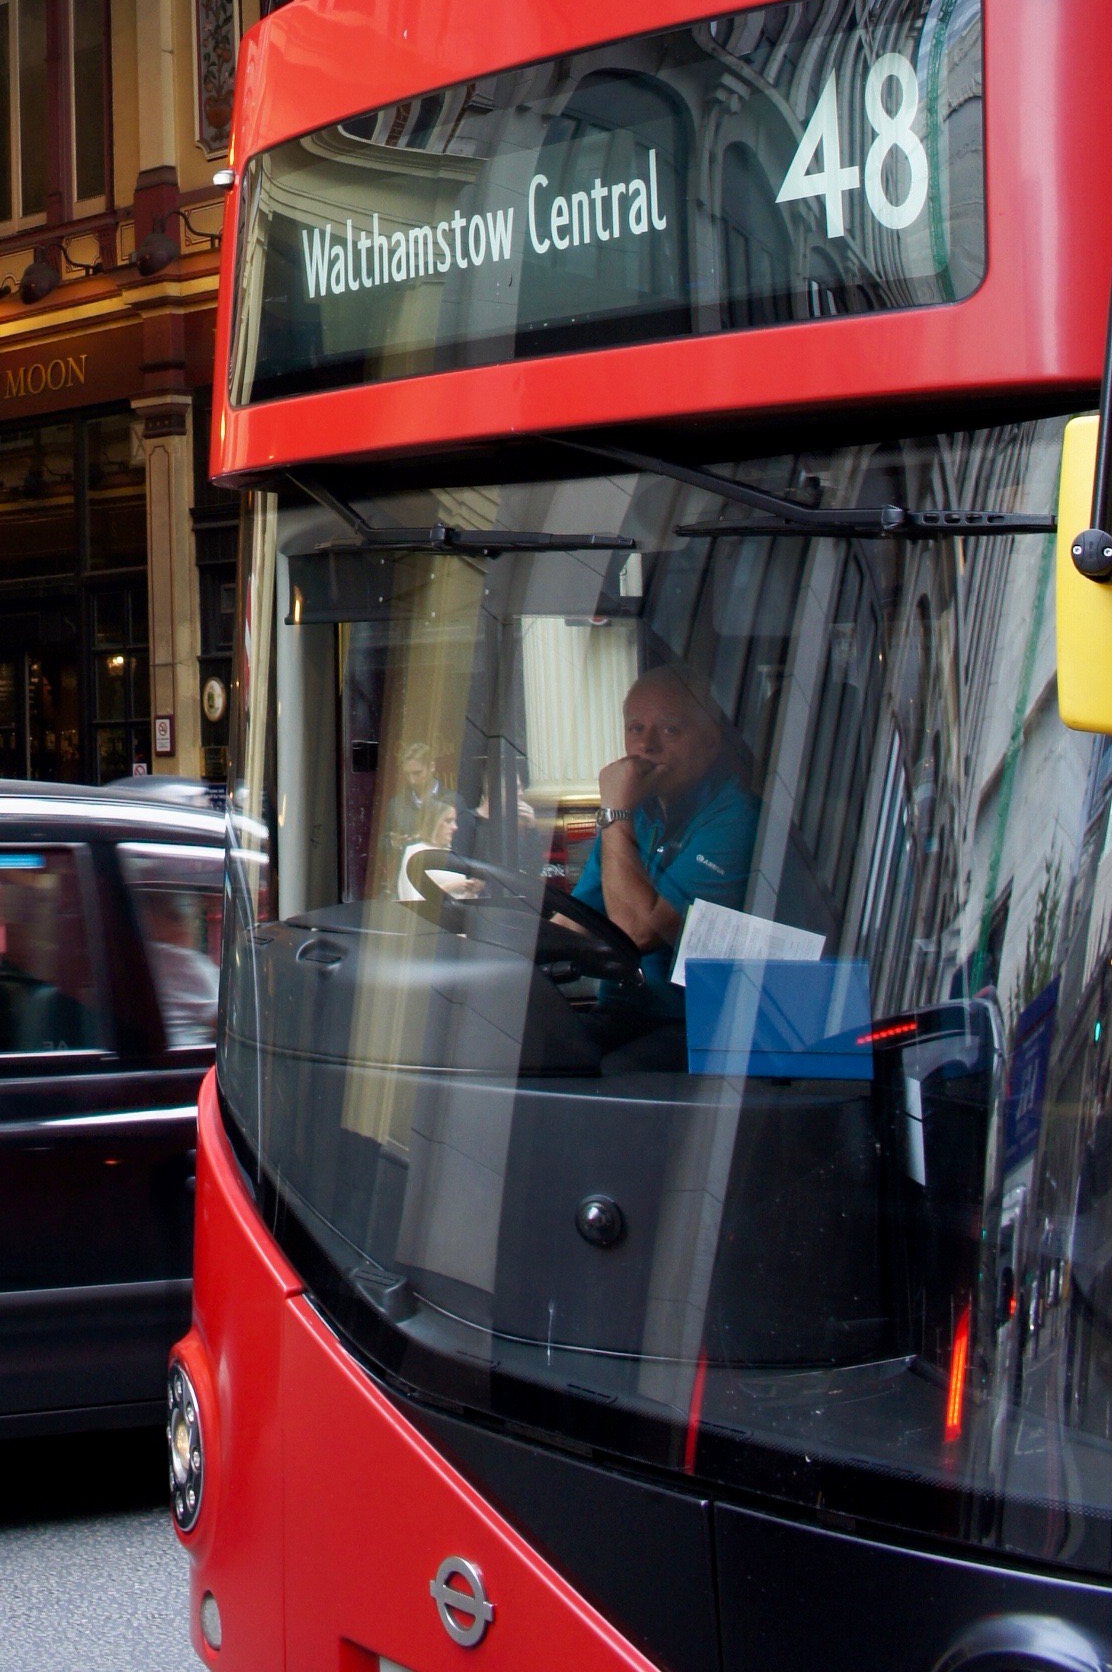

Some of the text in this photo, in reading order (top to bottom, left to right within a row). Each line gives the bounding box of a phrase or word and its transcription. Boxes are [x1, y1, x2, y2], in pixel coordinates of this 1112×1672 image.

[775, 51, 929, 239] 48
[301, 148, 667, 299] Walthamstow Central
[4, 354, 88, 399] MOON
